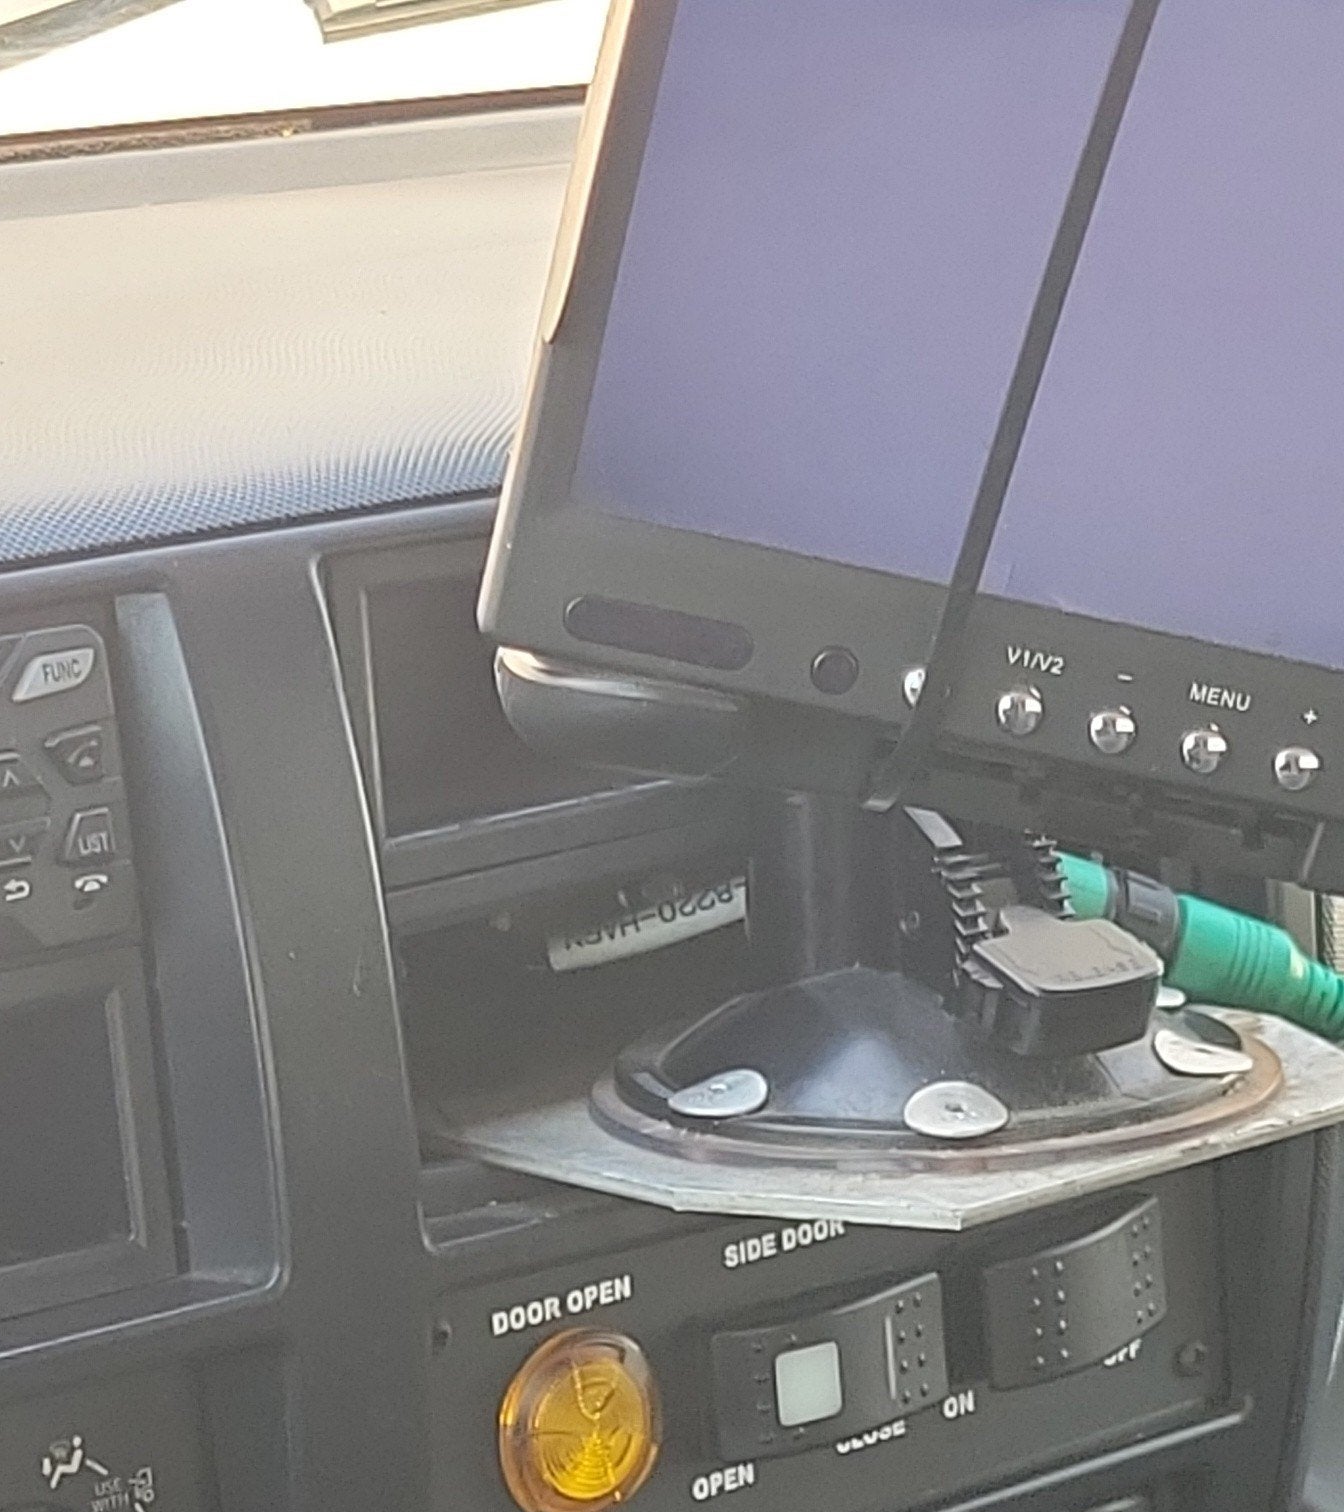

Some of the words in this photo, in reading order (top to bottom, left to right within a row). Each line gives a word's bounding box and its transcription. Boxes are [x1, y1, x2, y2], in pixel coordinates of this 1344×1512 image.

[42, 659, 82, 685] FUNC
[1188, 683, 1252, 712] MENU
[723, 1232, 777, 1268] SIDE
[781, 1219, 846, 1252] DOOR
[491, 1296, 562, 1336] DOOR
[566, 1274, 632, 1314] OPEN
[943, 1389, 976, 1420] ON
[693, 1462, 756, 1501] OPEN
